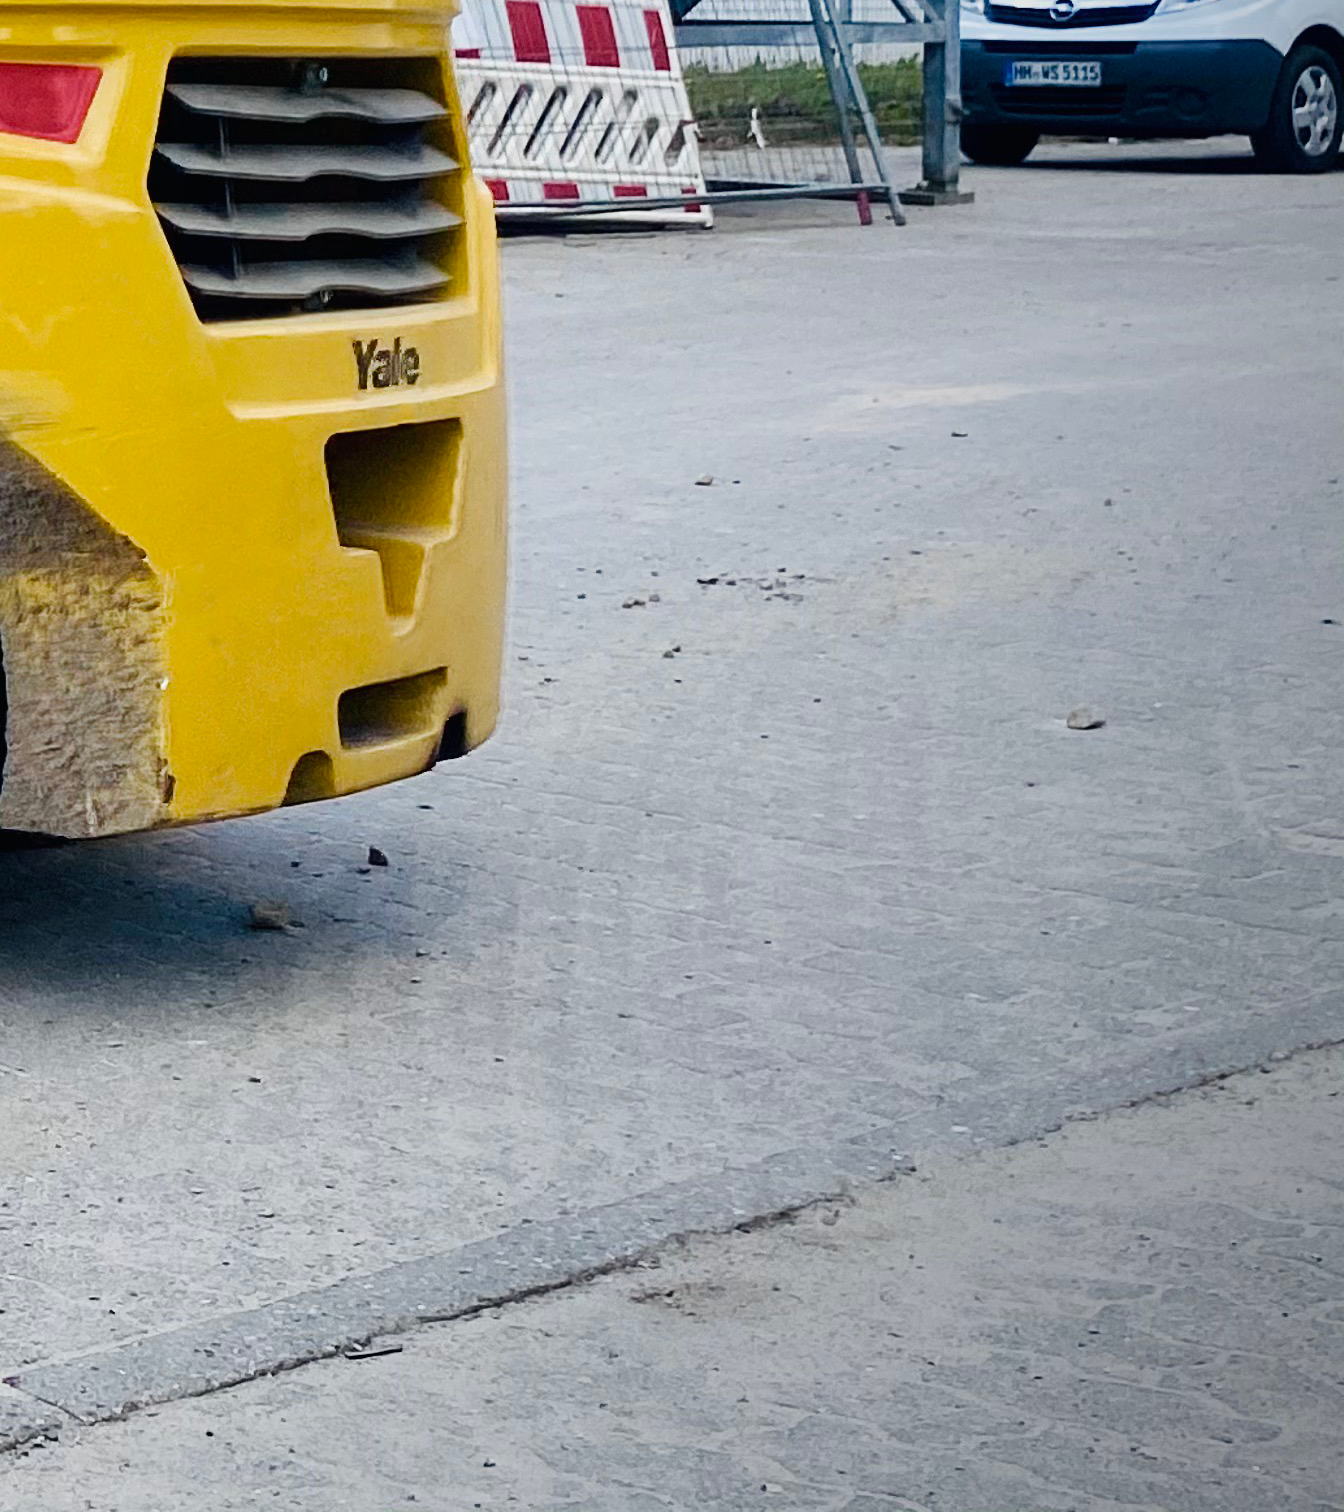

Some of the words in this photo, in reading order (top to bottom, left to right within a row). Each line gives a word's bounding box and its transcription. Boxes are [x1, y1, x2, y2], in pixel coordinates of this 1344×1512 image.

[1041, 65, 1059, 80] WS
[1062, 65, 1099, 81] 5115
[352, 336, 420, 390] Yale
